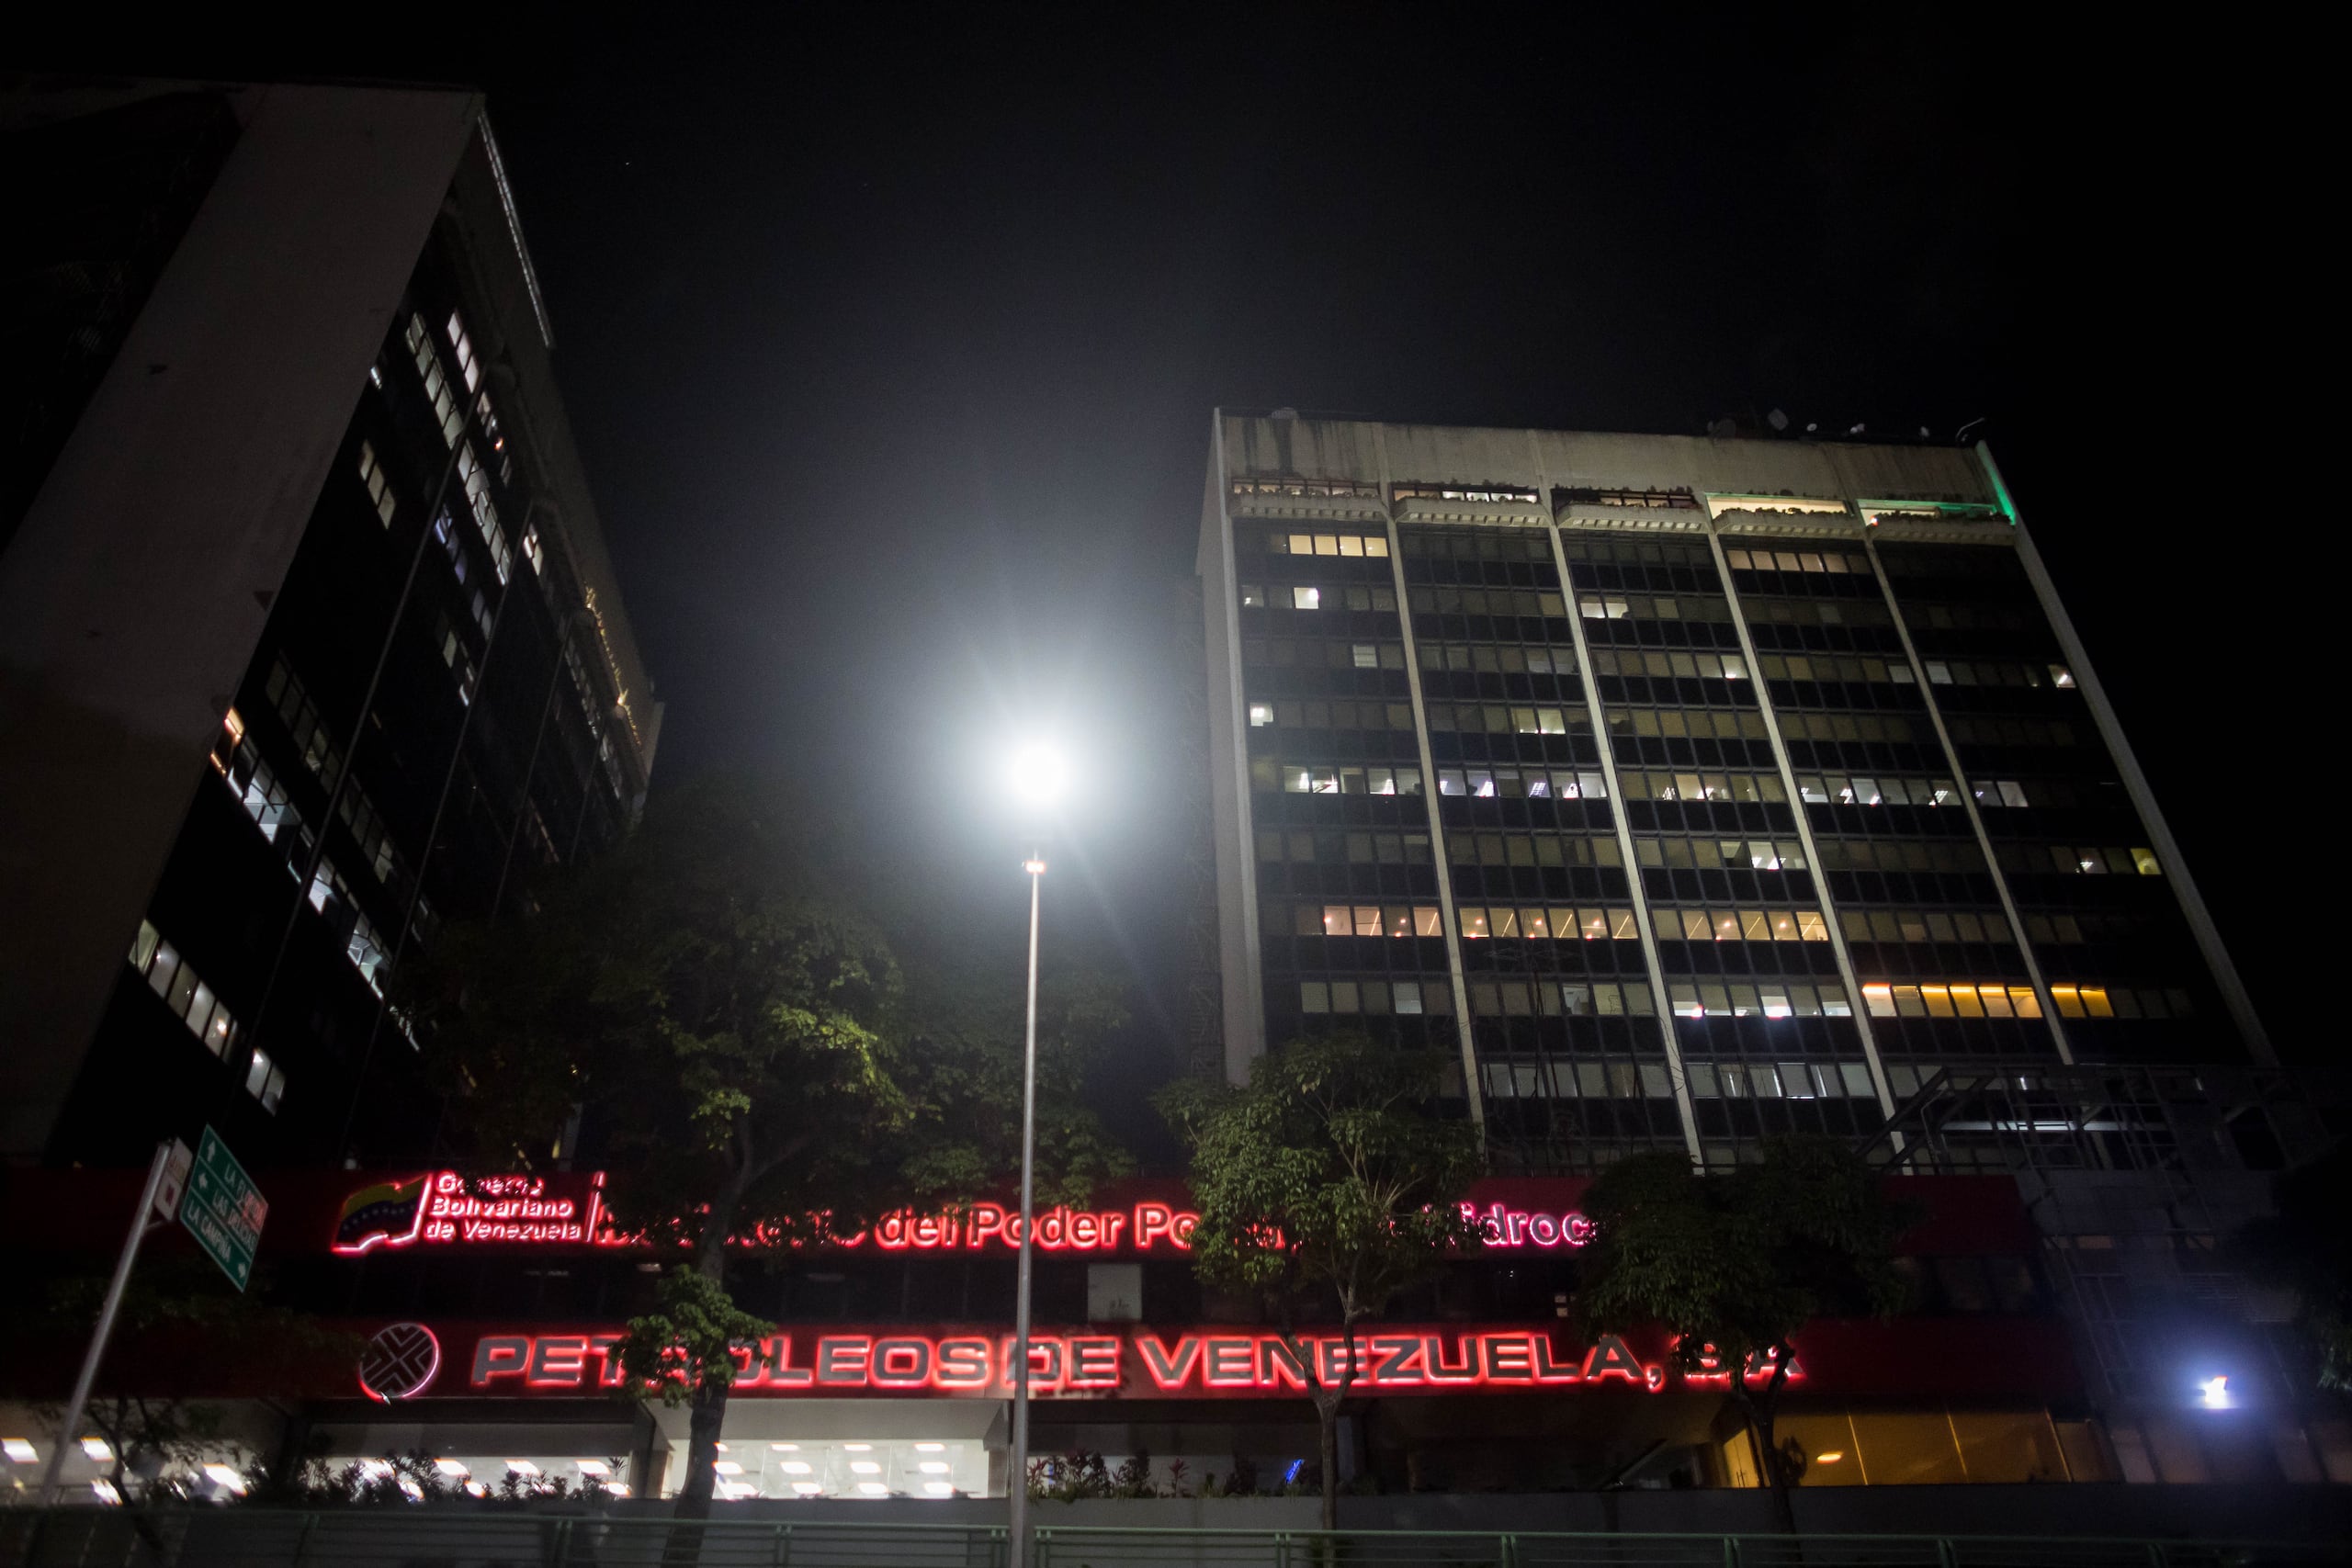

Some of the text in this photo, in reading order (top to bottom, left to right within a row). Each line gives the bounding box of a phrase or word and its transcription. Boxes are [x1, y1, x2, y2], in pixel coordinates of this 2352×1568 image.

[224, 1163, 236, 1188] LA
[187, 1199, 201, 1225] LA
[212, 1189, 230, 1218] LAS
[430, 1196, 574, 1218] Bolivariano
[424, 1219, 456, 1240] de
[462, 1220, 582, 1240] Venezuela
[967, 1203, 1123, 1248] Poder
[1007, 1335, 1121, 1387] DE
